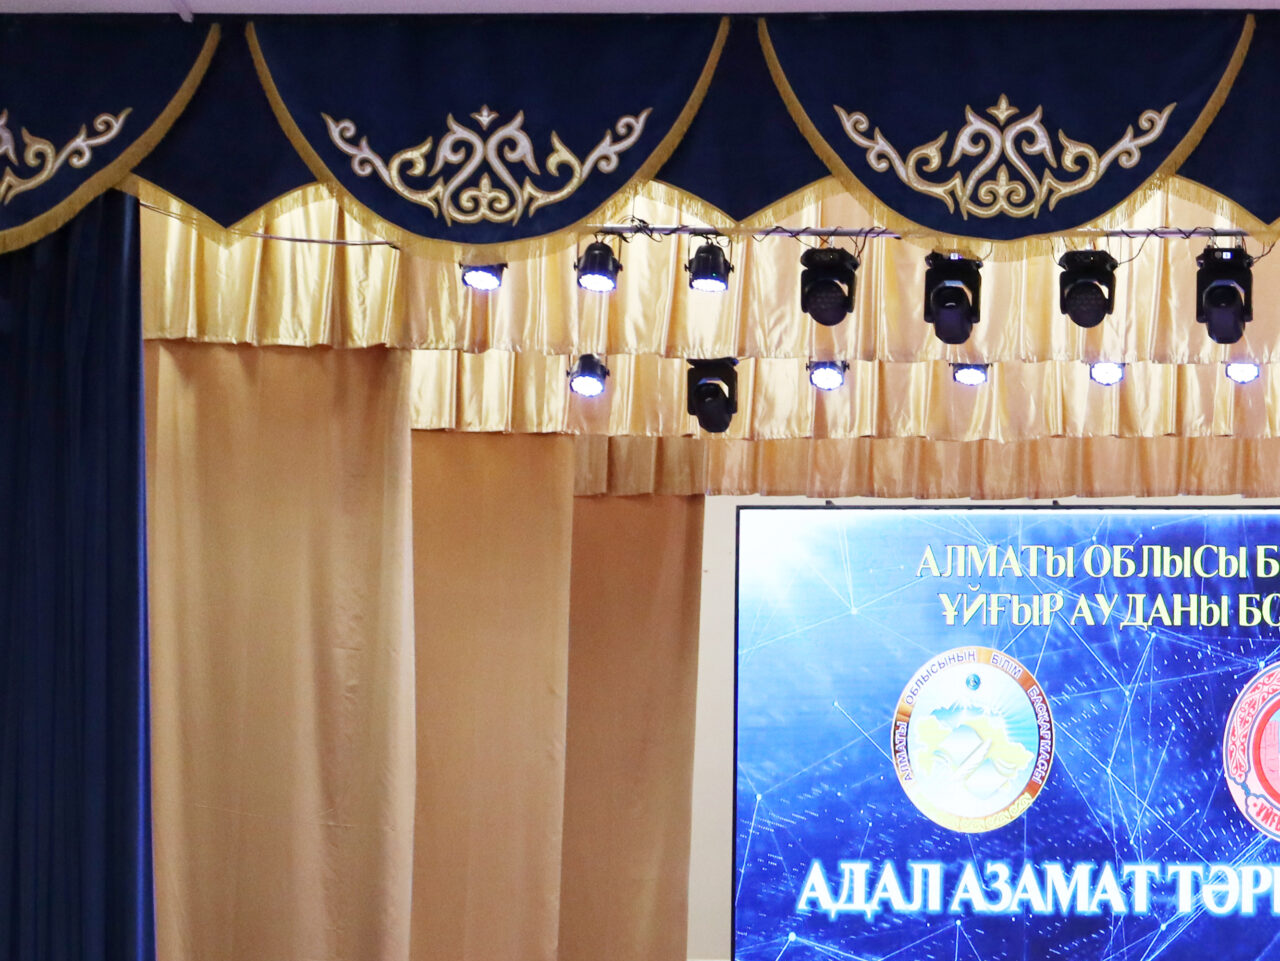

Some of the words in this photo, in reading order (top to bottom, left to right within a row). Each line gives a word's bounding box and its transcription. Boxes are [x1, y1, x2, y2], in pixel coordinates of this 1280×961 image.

[916, 544, 1075, 578] АЛМАТЫ
[1083, 544, 1247, 578] ОБЛЫСЫ
[938, 583, 1064, 626] ҰЙҒЫР
[1071, 592, 1229, 630] АУДАНЫ
[895, 721, 912, 781] АЛМАТЫ
[991, 652, 1023, 679] БІЛІМ
[798, 862, 942, 919] АДАЛ
[950, 862, 1163, 915] АЗАМАТ
